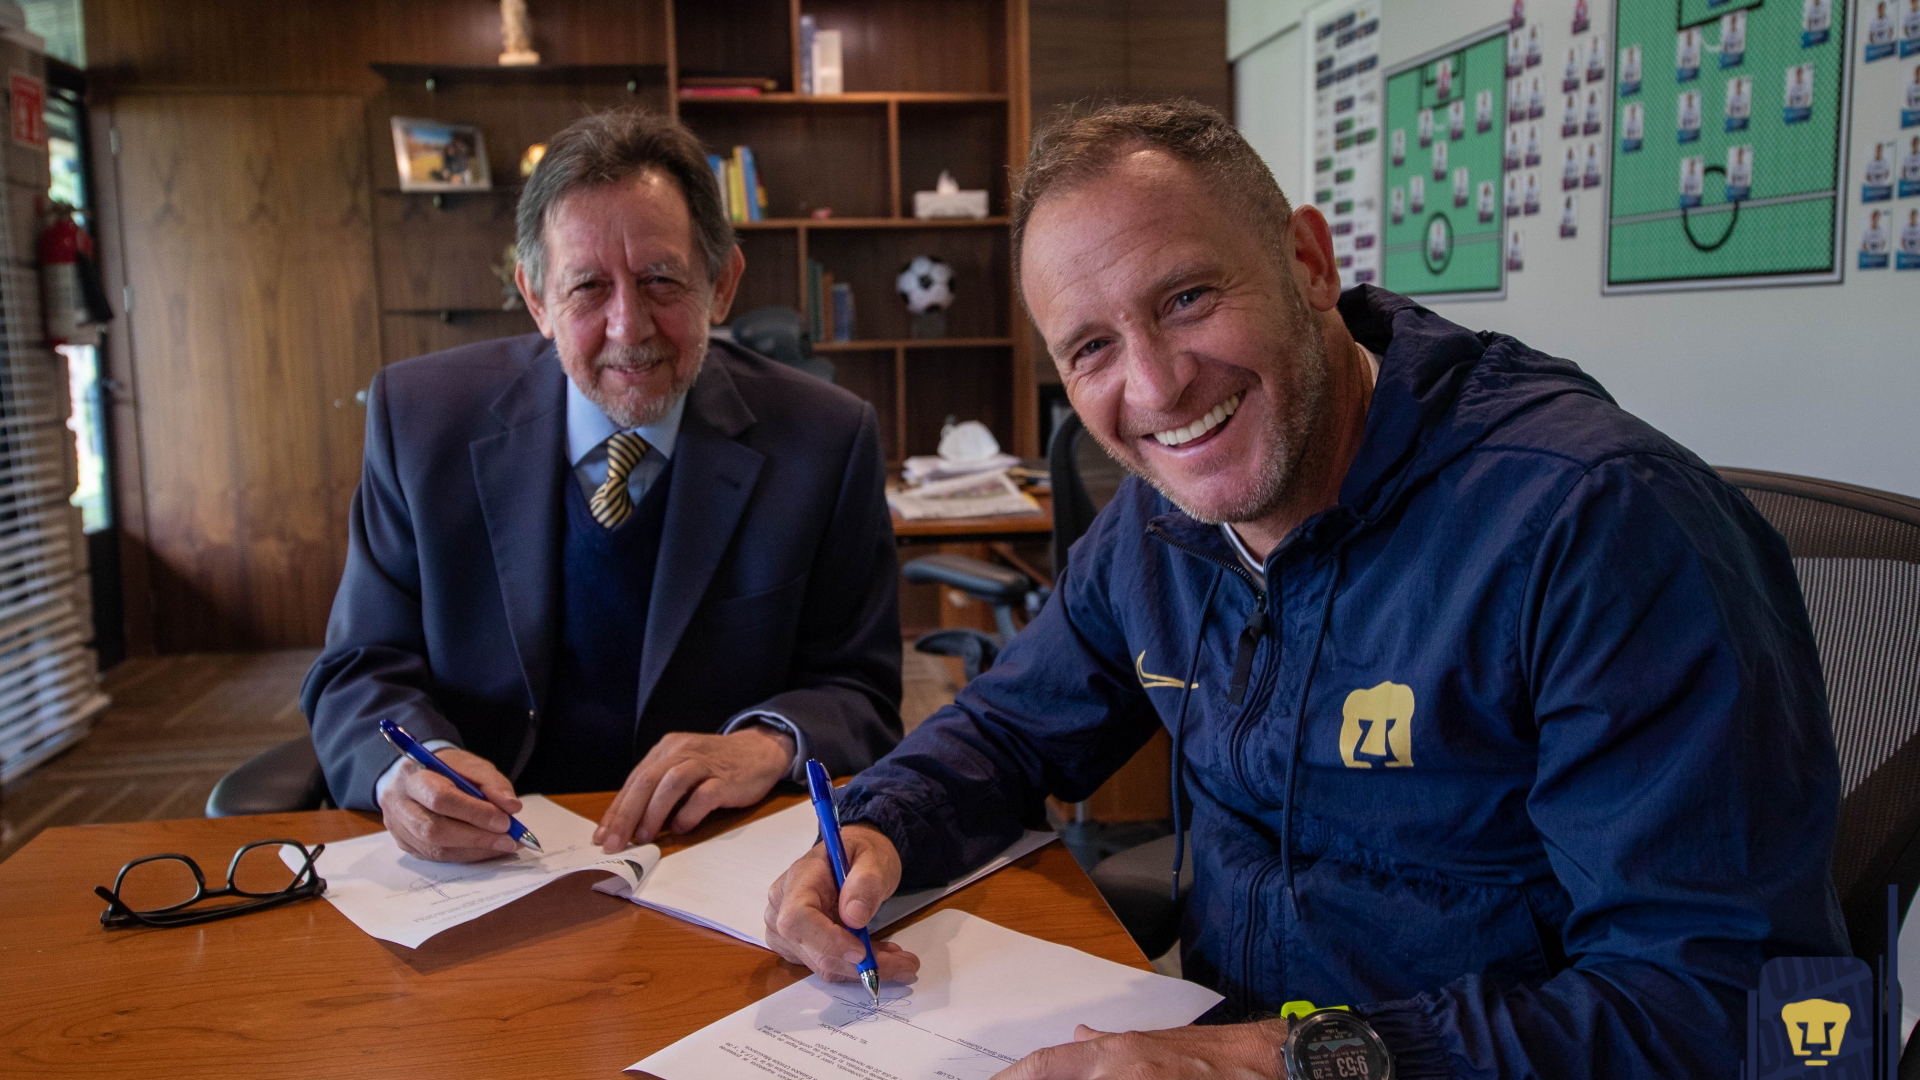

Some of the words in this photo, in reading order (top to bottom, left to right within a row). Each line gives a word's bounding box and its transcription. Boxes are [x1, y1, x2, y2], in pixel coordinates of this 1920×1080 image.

[771, 1059, 790, 1069] Unidos
[837, 1052, 865, 1066] noviembre
[1336, 1054, 1369, 1078] 9:53
[790, 1067, 812, 1079] Estados
[1312, 1067, 1324, 1080] 20
